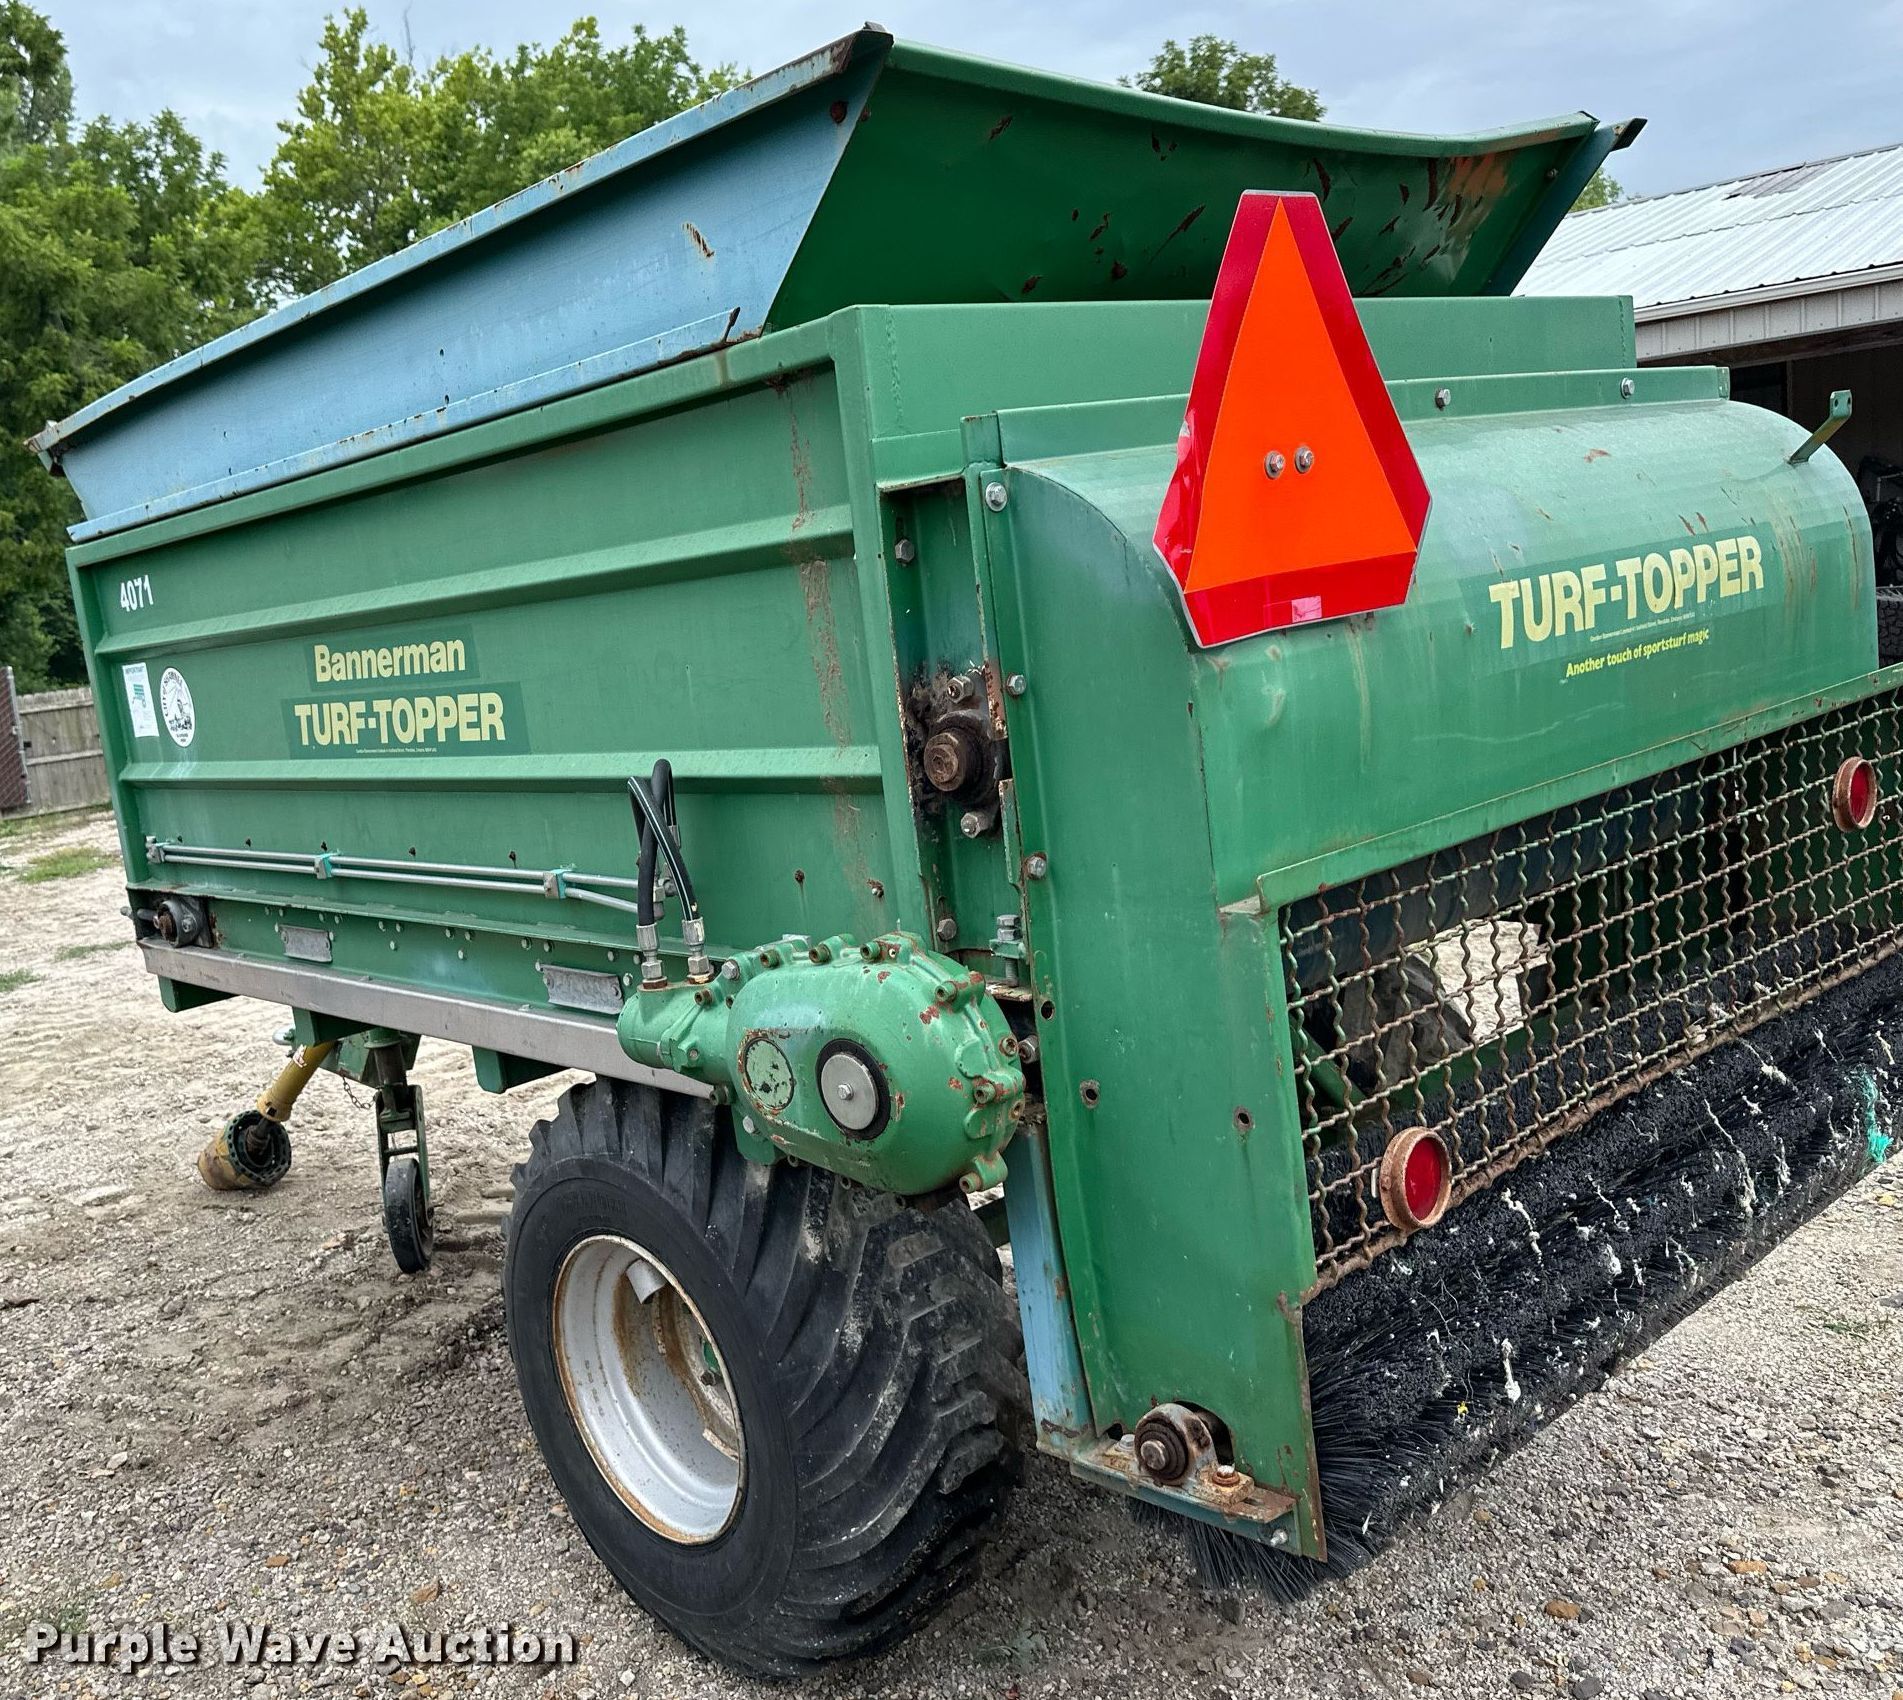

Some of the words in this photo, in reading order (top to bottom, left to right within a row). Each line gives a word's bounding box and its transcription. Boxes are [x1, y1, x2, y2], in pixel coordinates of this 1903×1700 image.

[121, 575, 153, 612] 4071
[1489, 535, 1764, 649] TURF-TOPPER
[314, 638, 466, 683] Bannerman
[1566, 656, 1605, 678] Another
[1606, 647, 1632, 666] touch
[1633, 644, 1642, 658] of
[1643, 631, 1687, 659] sportsturf
[1687, 628, 1710, 645] magic
[294, 692, 506, 746] TURF-TOPPER
